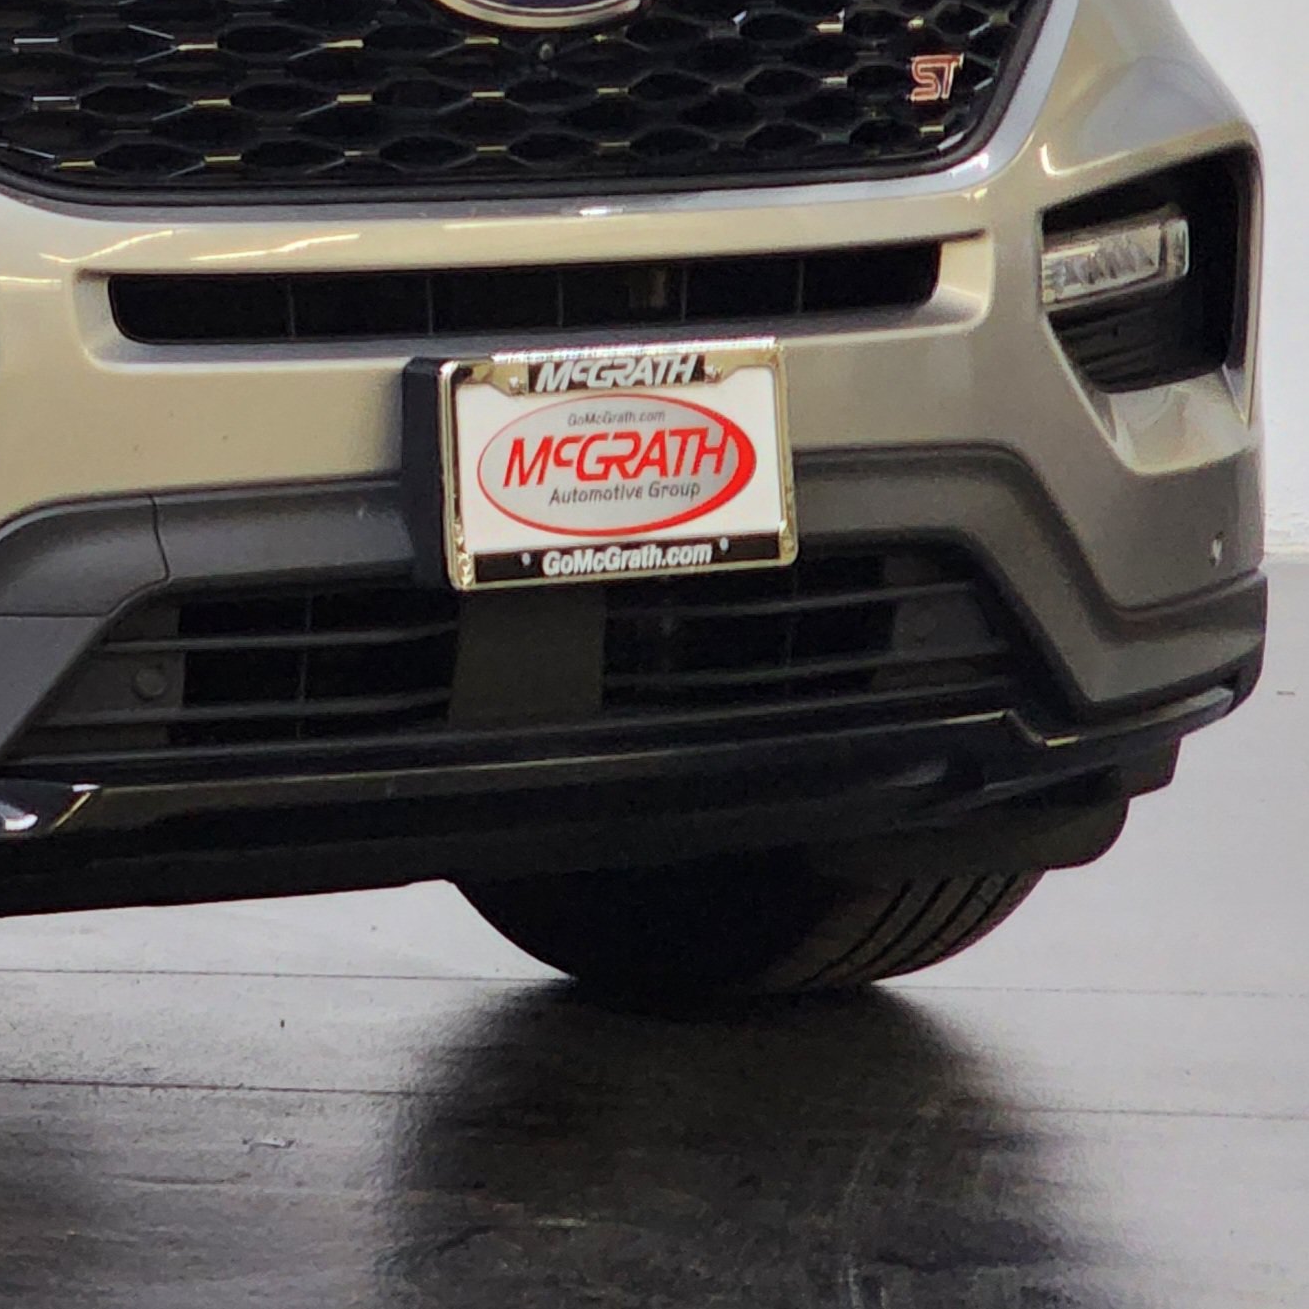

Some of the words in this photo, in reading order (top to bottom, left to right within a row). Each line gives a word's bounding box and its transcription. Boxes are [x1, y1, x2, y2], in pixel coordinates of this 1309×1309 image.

[911, 54, 964, 100] ST
[567, 410, 666, 427] GoMcGrath.com
[549, 485, 644, 506] Automotive
[648, 480, 702, 501] Group
[542, 542, 713, 577] GoMcGrath.com
